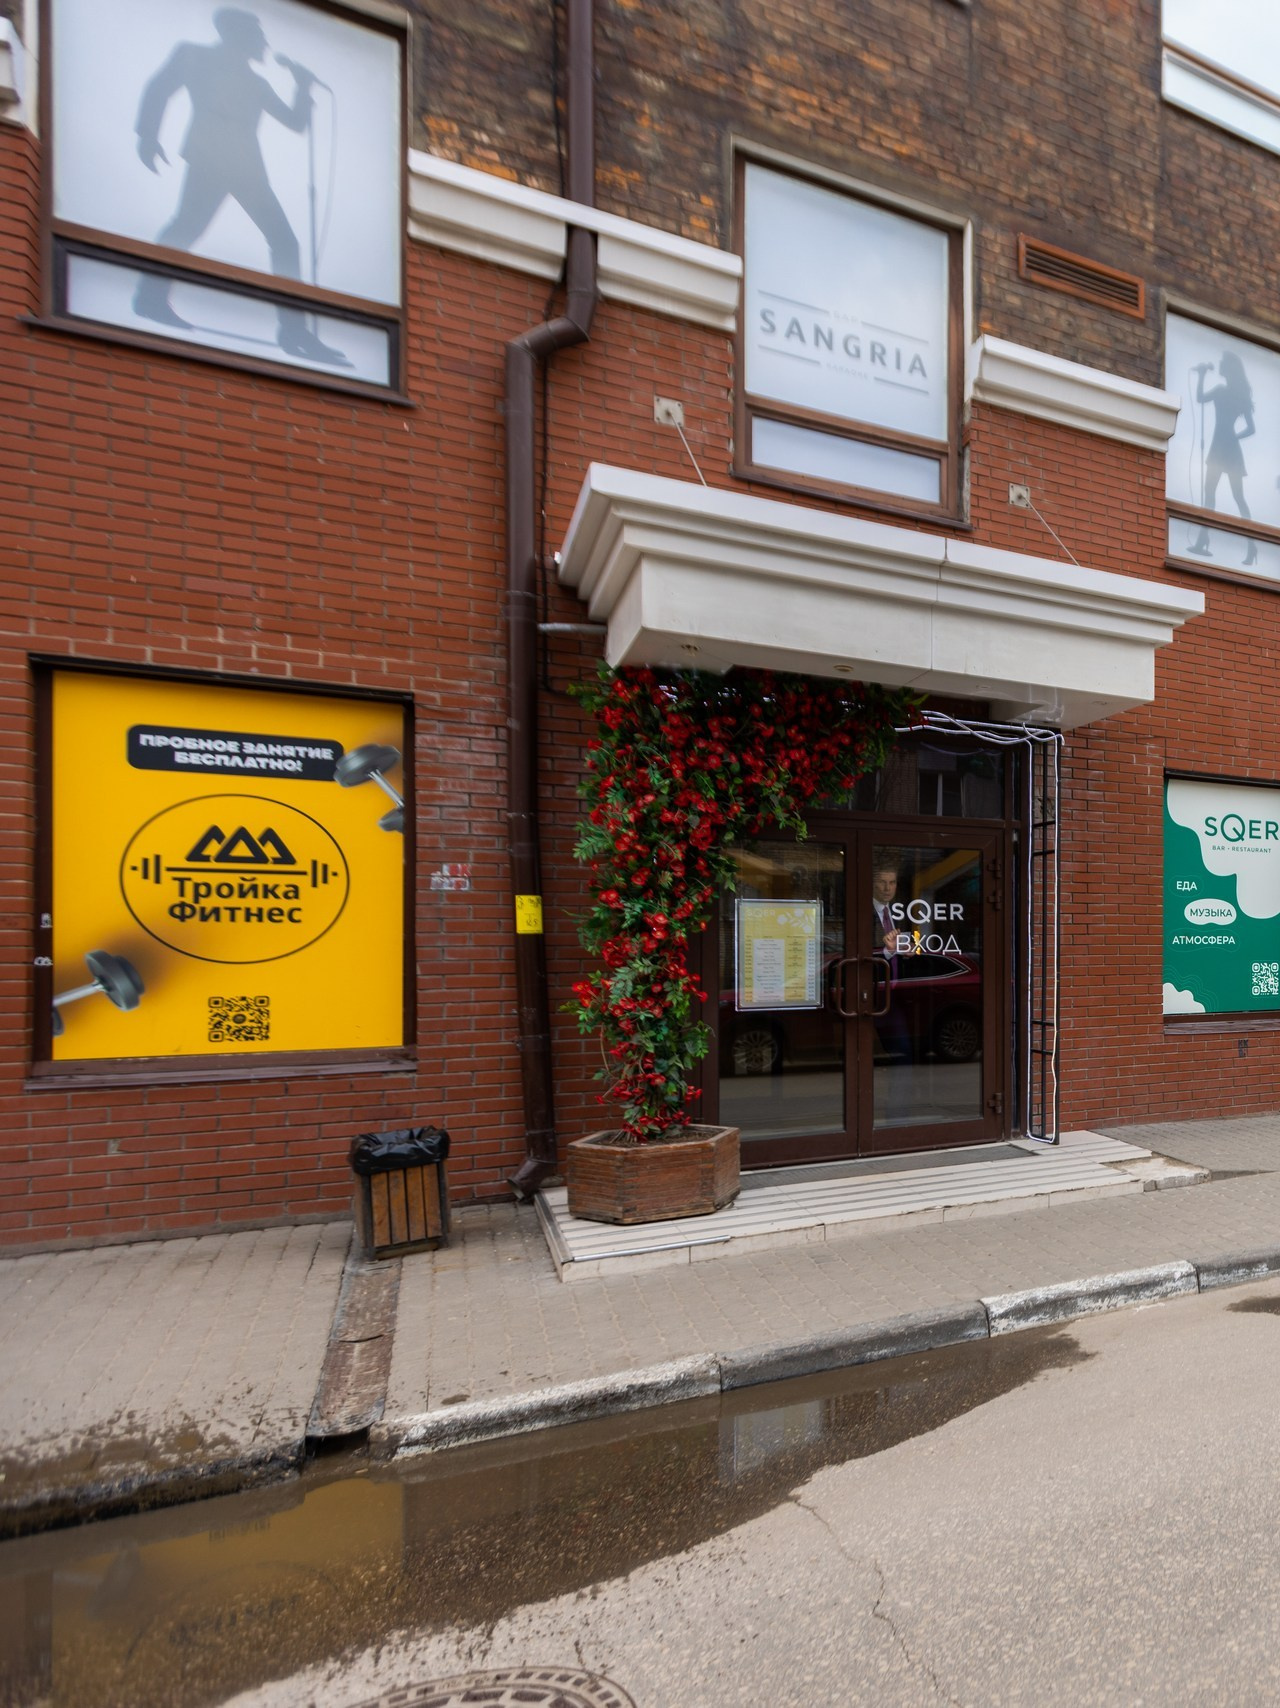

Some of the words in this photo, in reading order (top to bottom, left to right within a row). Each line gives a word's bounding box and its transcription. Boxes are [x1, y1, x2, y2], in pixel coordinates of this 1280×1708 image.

[760, 308, 928, 378] SANGRIA
[139, 733, 240, 754] ПРОБНОЕ
[242, 742, 335, 761] ЗАНЯТИЕ
[174, 751, 304, 773] БЕСПЛАТНО!
[1204, 813, 1279, 843] SQER
[1231, 846, 1272, 854] RESTAURANT
[172, 876, 300, 904] Тройка
[1176, 880, 1198, 892] ЕДА
[168, 901, 302, 923] Фитнес
[891, 899, 964, 924] SQER
[1190, 908, 1233, 918] МУЗЫКА
[896, 934, 962, 956] ВХОД
[1172, 935, 1236, 945] АТМОСФЕРА
